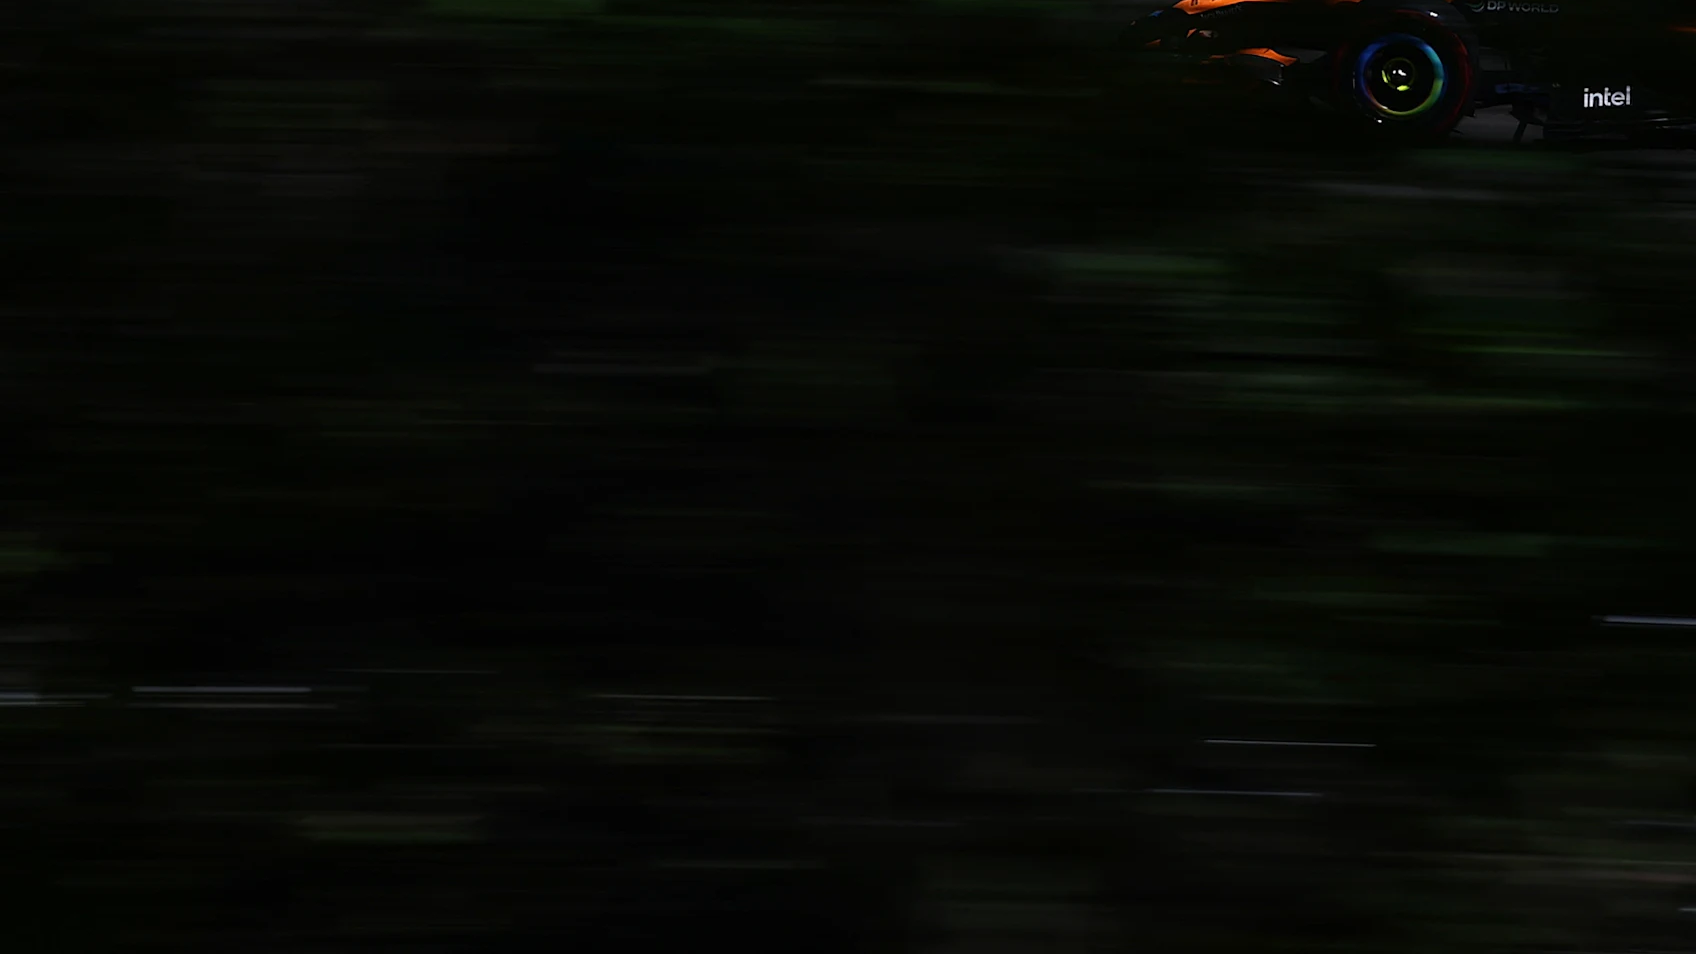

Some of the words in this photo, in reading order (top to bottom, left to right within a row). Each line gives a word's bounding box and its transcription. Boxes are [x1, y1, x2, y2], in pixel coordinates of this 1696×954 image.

[1487, 0, 1507, 11] DP
[1508, 1, 1559, 13] WORLD
[1583, 85, 1631, 109] intel
